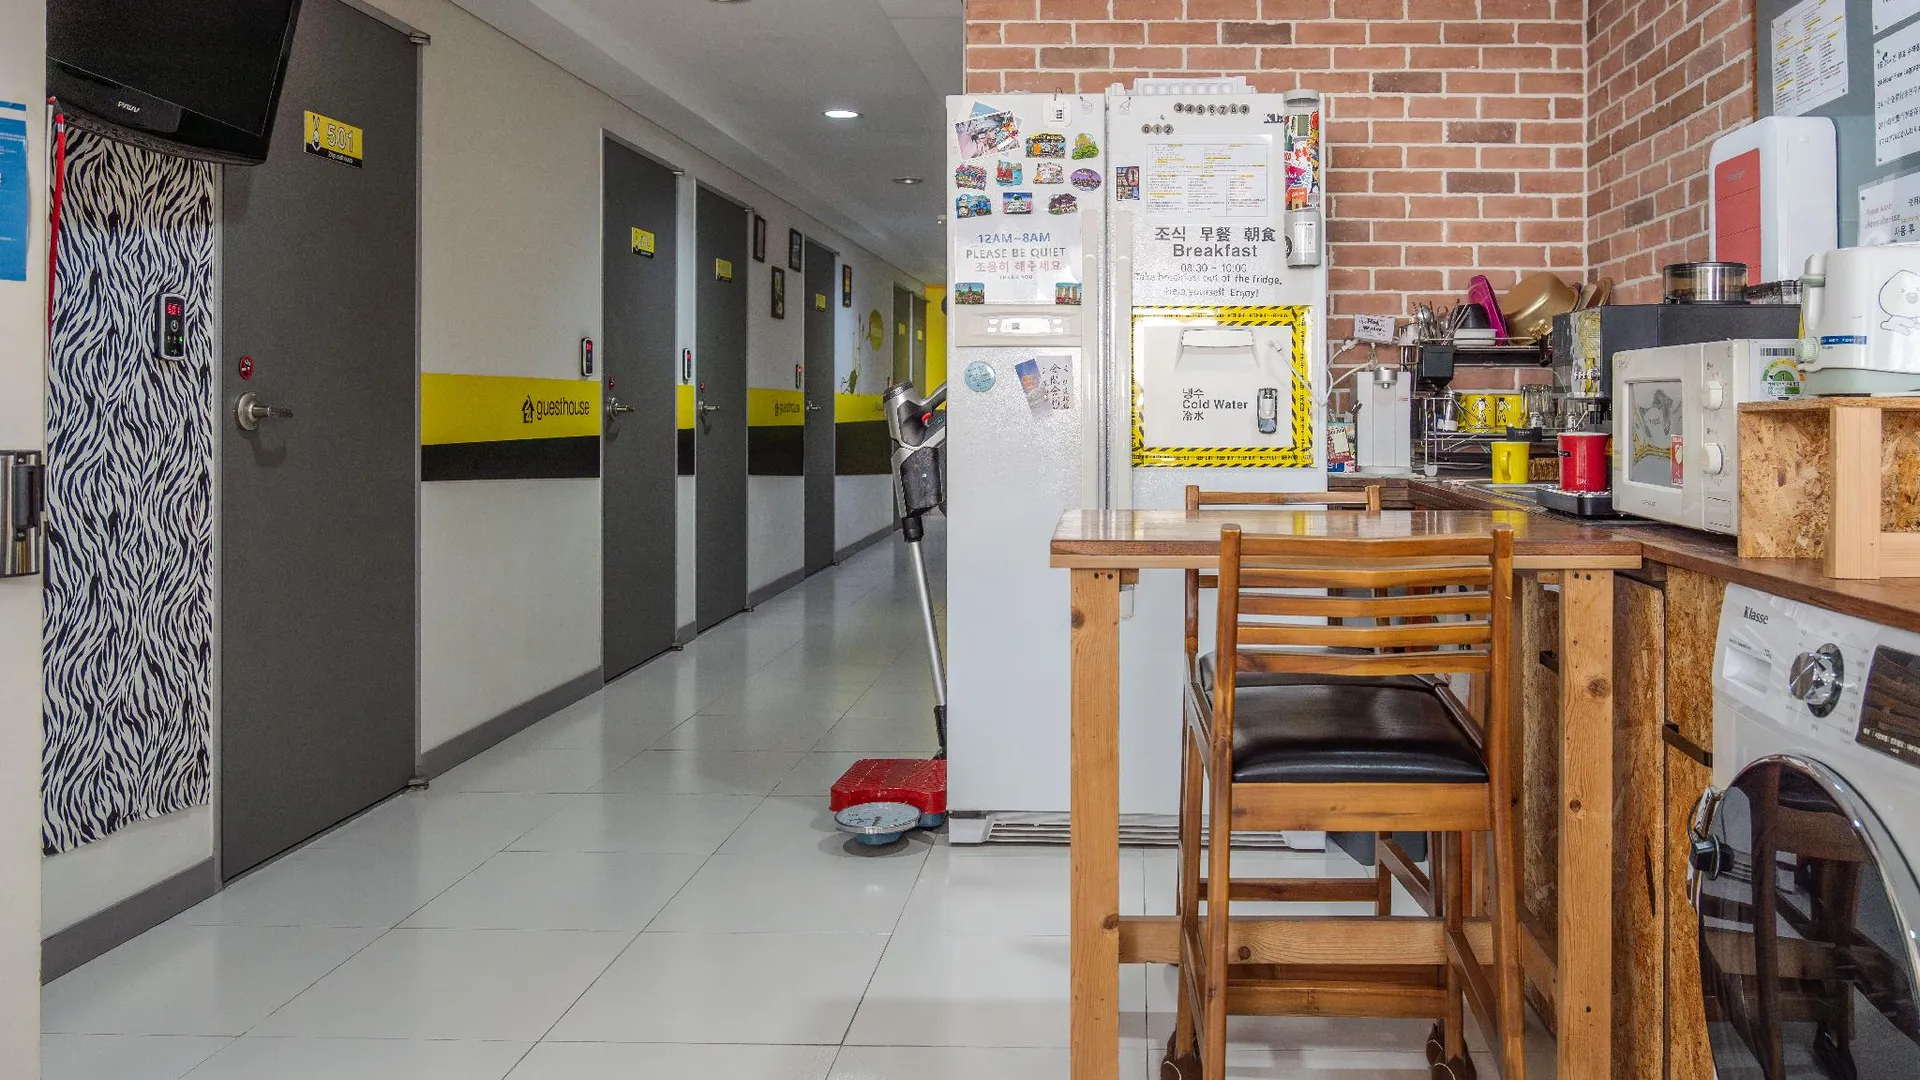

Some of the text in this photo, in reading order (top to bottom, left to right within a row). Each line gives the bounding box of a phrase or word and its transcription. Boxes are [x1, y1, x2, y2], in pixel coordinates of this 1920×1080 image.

[327, 123, 353, 152] 501
[978, 233, 1050, 244] 12AM~8AM
[1155, 226, 1276, 242] 조식 早餐 朝食
[966, 247, 1066, 259] PLEASE BE QUIET
[1173, 243, 1258, 257] Breakfast
[975, 260, 1061, 273] 조용히 해주세요
[1221, 274, 1230, 283] of
[1235, 274, 1250, 284] the
[1253, 275, 1283, 286] fridge.
[1231, 288, 1259, 299] Enjoy!
[1182, 388, 1204, 400] 냉수
[536, 396, 590, 420] guesthouse
[1182, 400, 1249, 409] Cold Water
[1182, 411, 1204, 421] 冷水
